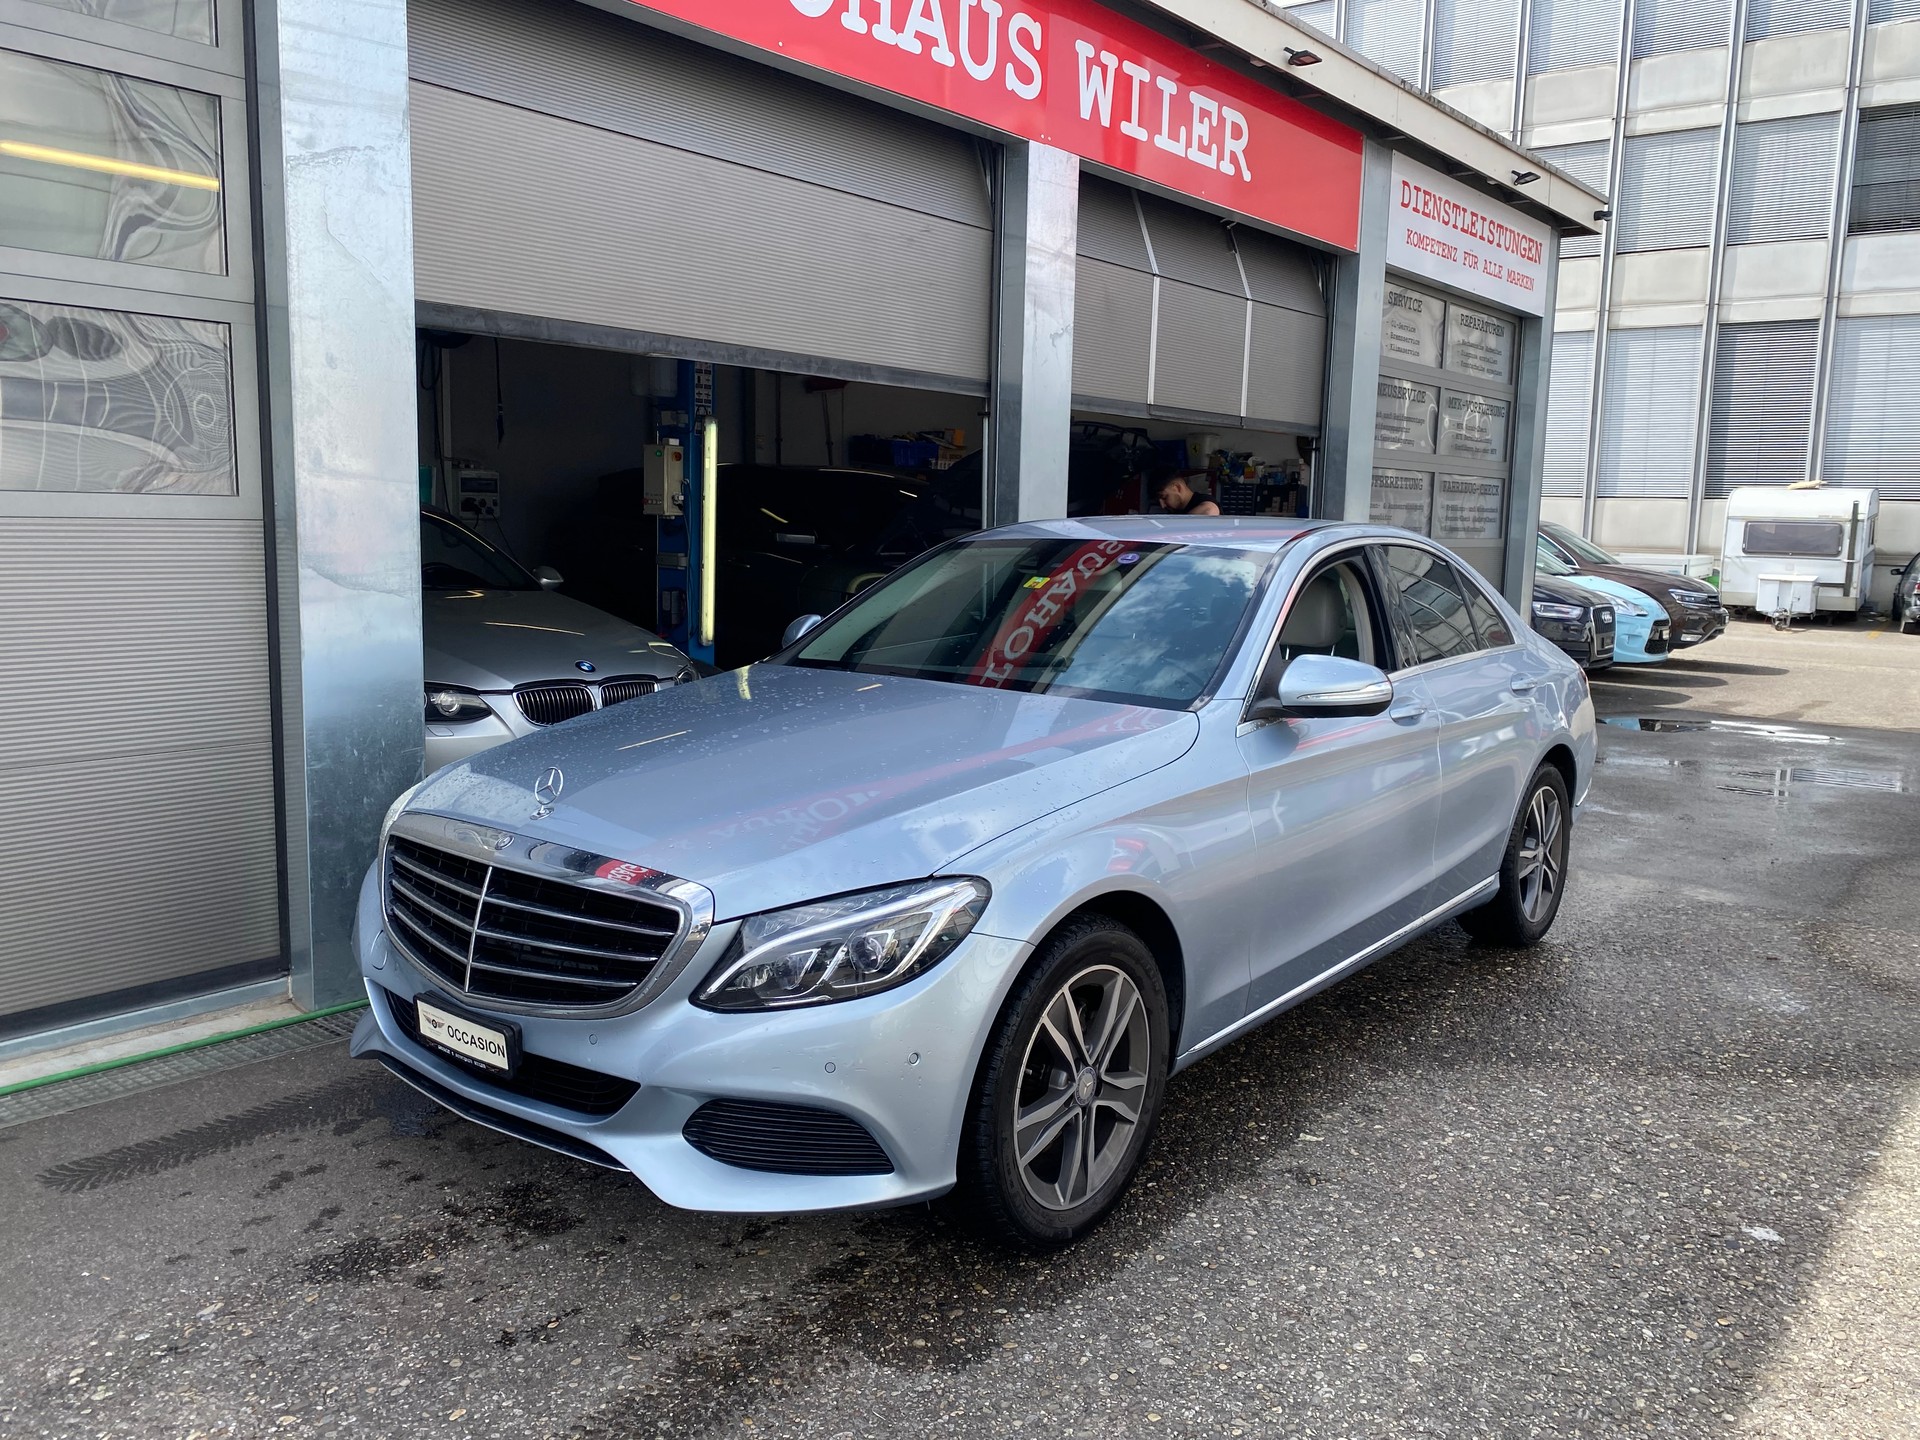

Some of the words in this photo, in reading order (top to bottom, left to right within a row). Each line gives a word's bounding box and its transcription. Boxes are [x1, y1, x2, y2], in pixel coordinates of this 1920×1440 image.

[788, 0, 1043, 100] AUS
[1075, 39, 1252, 182] WILER
[1400, 179, 1543, 265] DIENSTLEISTUNGEN
[1406, 228, 1458, 263] KOMPETENZ
[1463, 249, 1479, 271] FÜR
[1483, 259, 1504, 280] ALLE
[1506, 268, 1535, 292] MARKEN
[1387, 290, 1423, 313] SERVICE
[1460, 313, 1505, 338] REPARATUREN
[447, 1025, 506, 1058] OCCASION
